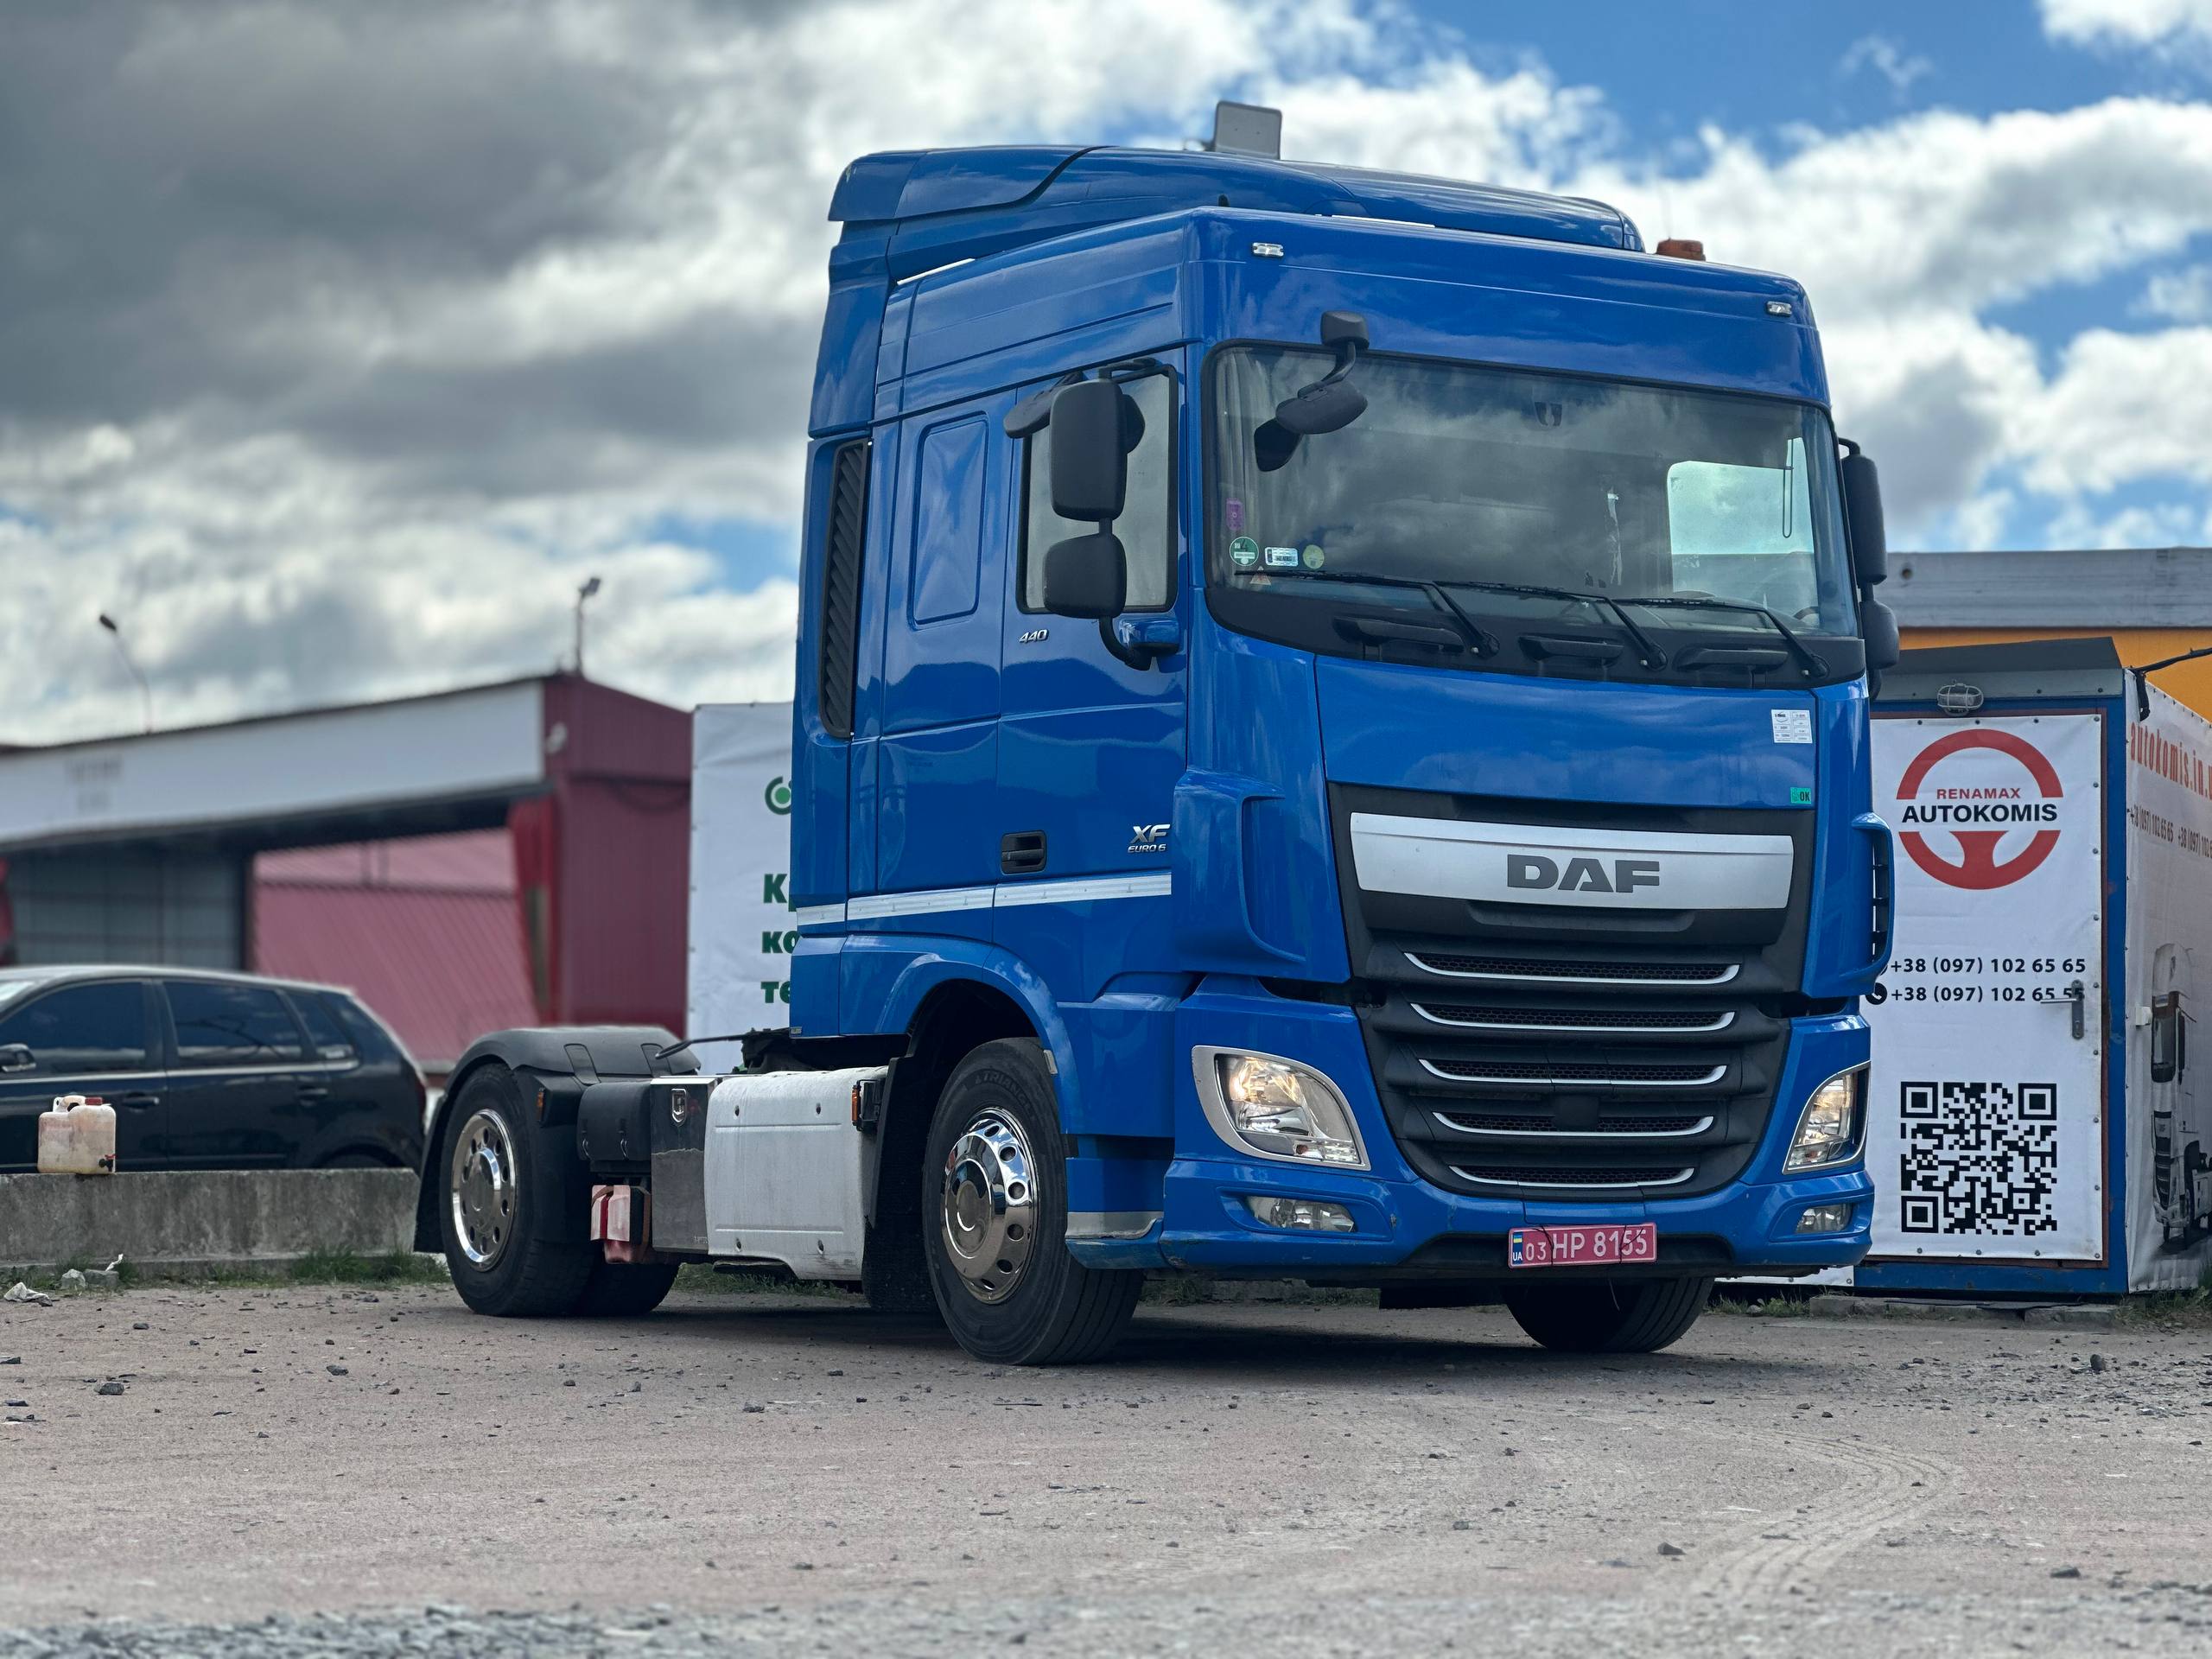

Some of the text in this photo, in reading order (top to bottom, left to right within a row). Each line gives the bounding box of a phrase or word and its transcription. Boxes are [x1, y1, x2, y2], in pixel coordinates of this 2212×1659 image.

[1019, 629, 1048, 643] 440
[1800, 791, 1810, 801] OK
[1936, 788, 2021, 799] RENAMAX
[1902, 804, 2058, 823] AUTOKOMIS
[1130, 823, 1170, 843] XF
[1508, 854, 1660, 893] DAF
[1891, 957, 2086, 974] +38 (097) 102 65 65
[1891, 987, 1927, 1001] +38
[1934, 986, 1983, 1003] (097)
[1992, 987, 2025, 1001] 102
[2032, 987, 2055, 1001] 65
[1525, 1230, 1648, 1261] 03 HP 8155
[1513, 1252, 1522, 1262] UA
